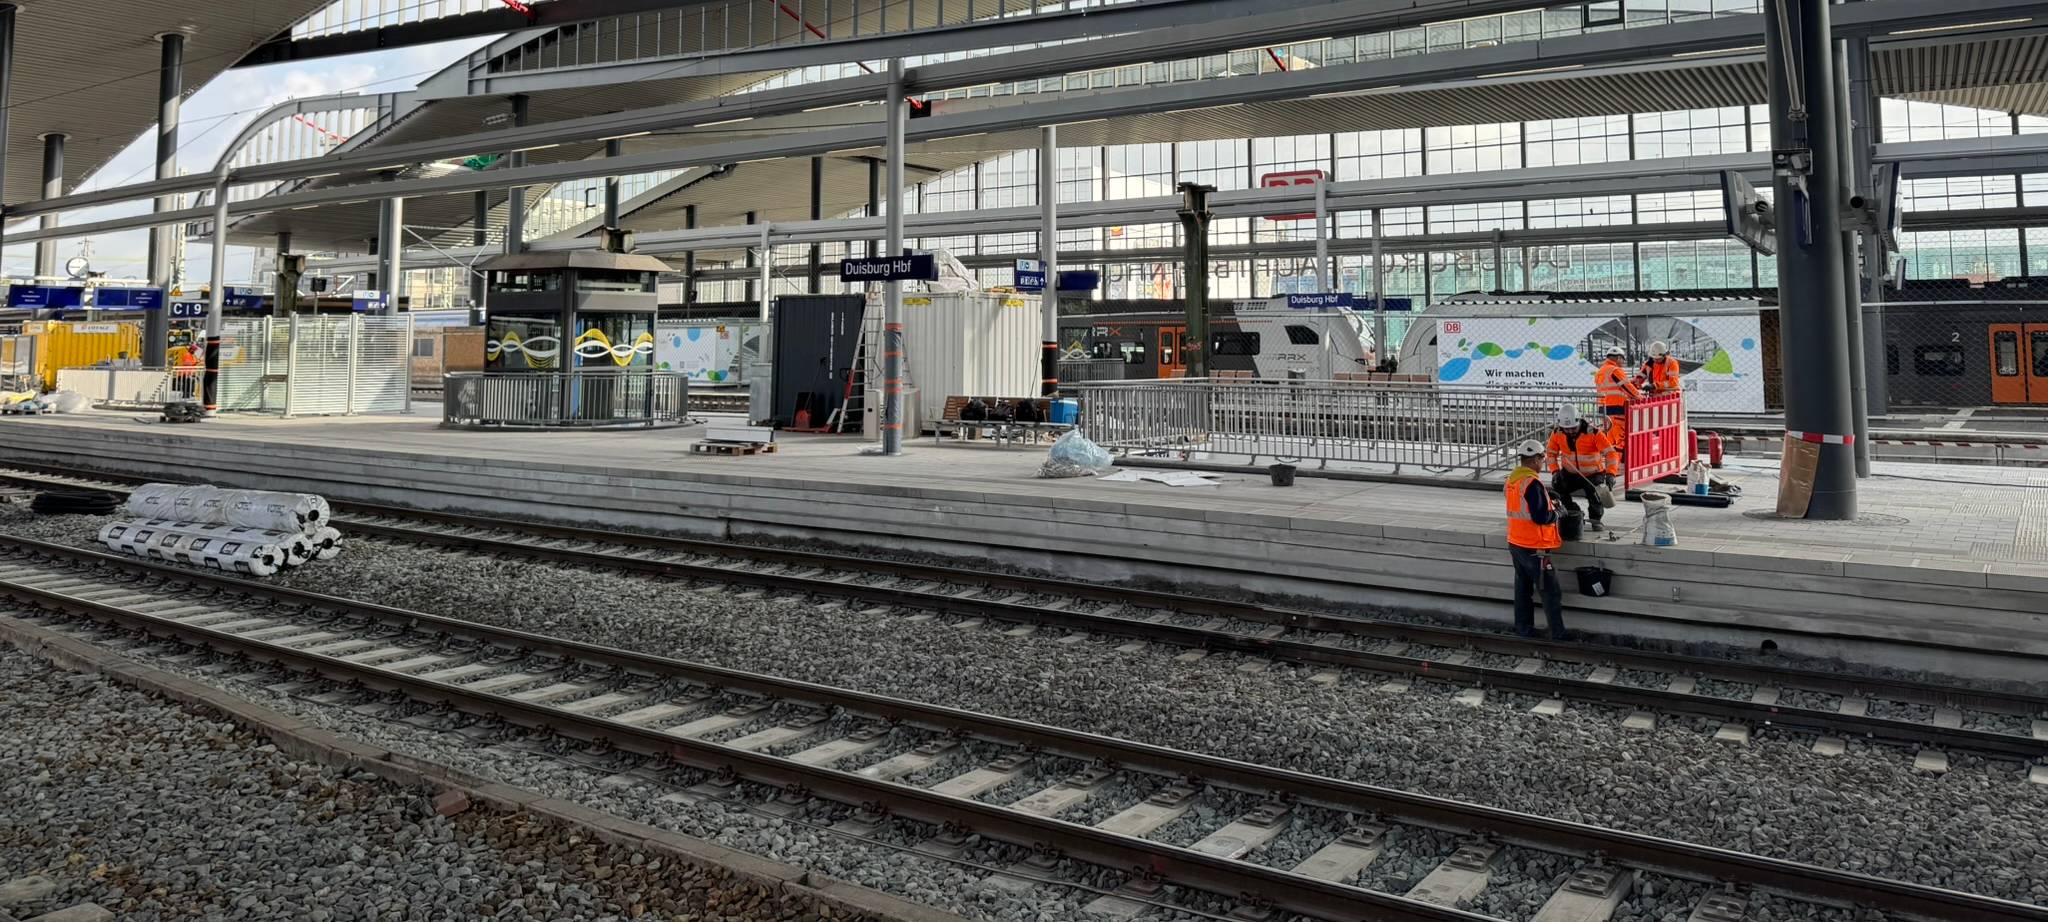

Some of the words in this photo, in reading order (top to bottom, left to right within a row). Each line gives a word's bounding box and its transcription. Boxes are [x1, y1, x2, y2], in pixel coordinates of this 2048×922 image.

[845, 262, 890, 276] Duisburg
[893, 260, 911, 273] Hbf
[1291, 295, 1323, 305] Duisburg
[1325, 295, 1339, 303] Hbf
[173, 303, 182, 315] C
[194, 302, 202, 314] 9
[1445, 322, 1459, 332] DB
[1951, 332, 1960, 342] 2
[1277, 353, 1306, 361] RRX
[1485, 369, 1502, 377] Wir
[1505, 369, 1545, 378] machen
